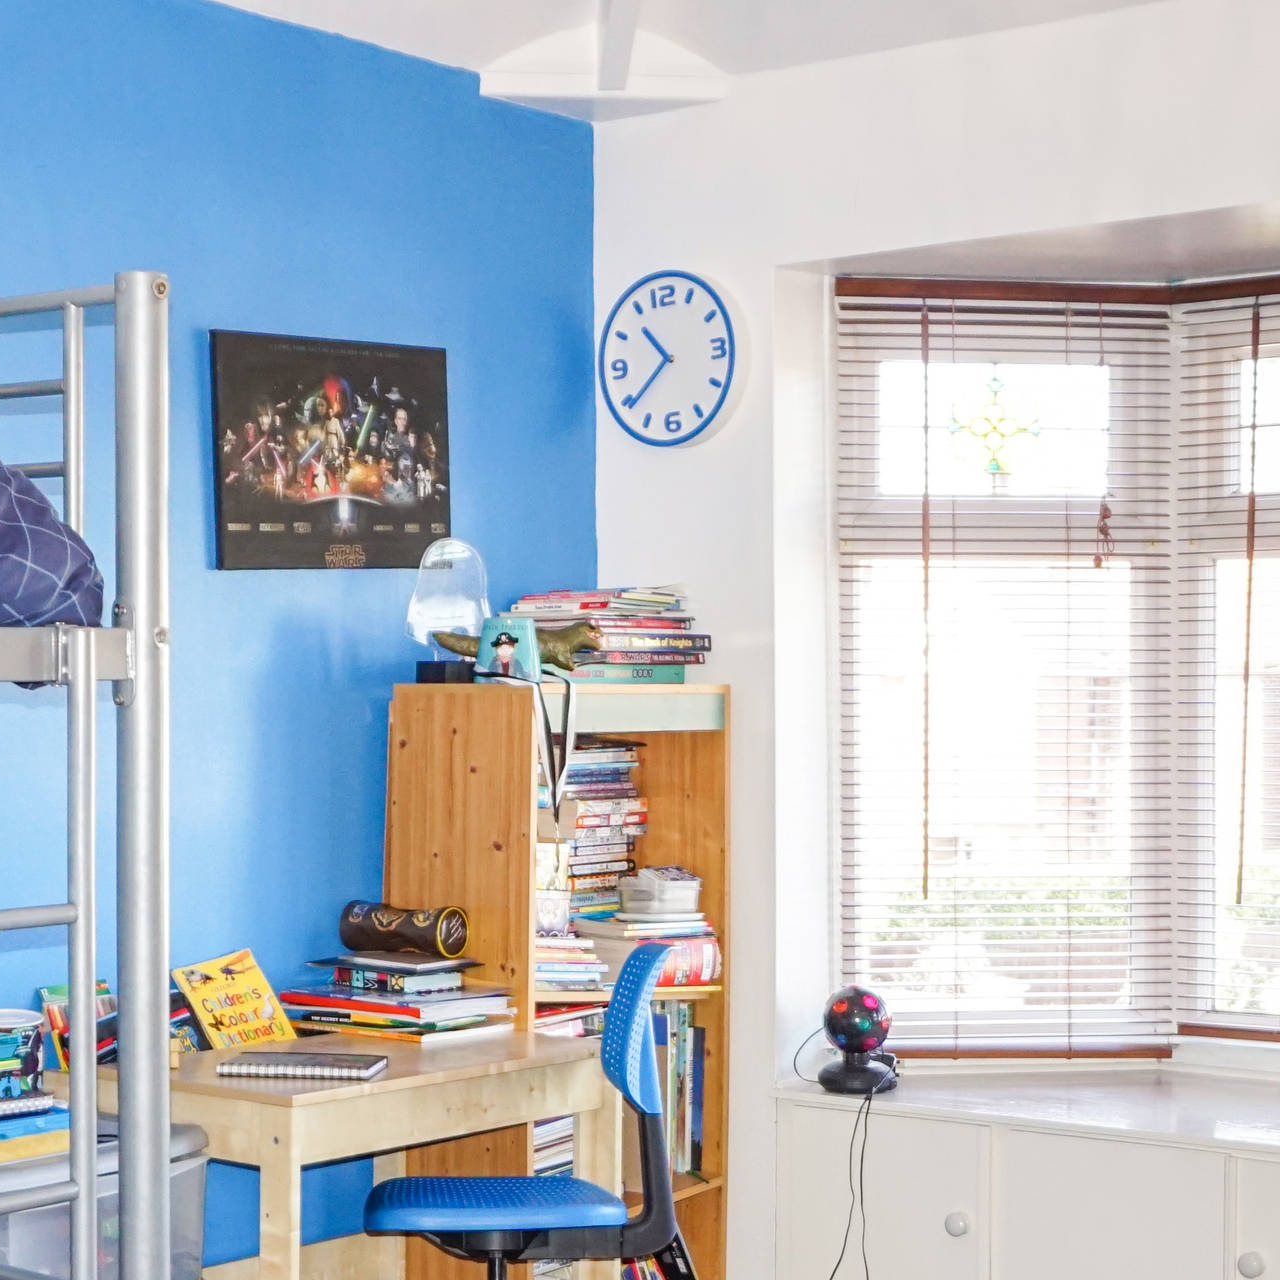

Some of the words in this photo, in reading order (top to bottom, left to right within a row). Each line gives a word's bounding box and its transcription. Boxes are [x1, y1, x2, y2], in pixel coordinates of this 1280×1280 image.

[650, 284, 676, 309] 12
[710, 336, 727, 360] 3
[610, 358, 628, 380] 9
[663, 411, 682, 433] 6
[219, 1007, 260, 1029] Colour
[217, 1020, 286, 1049] Dictionary
